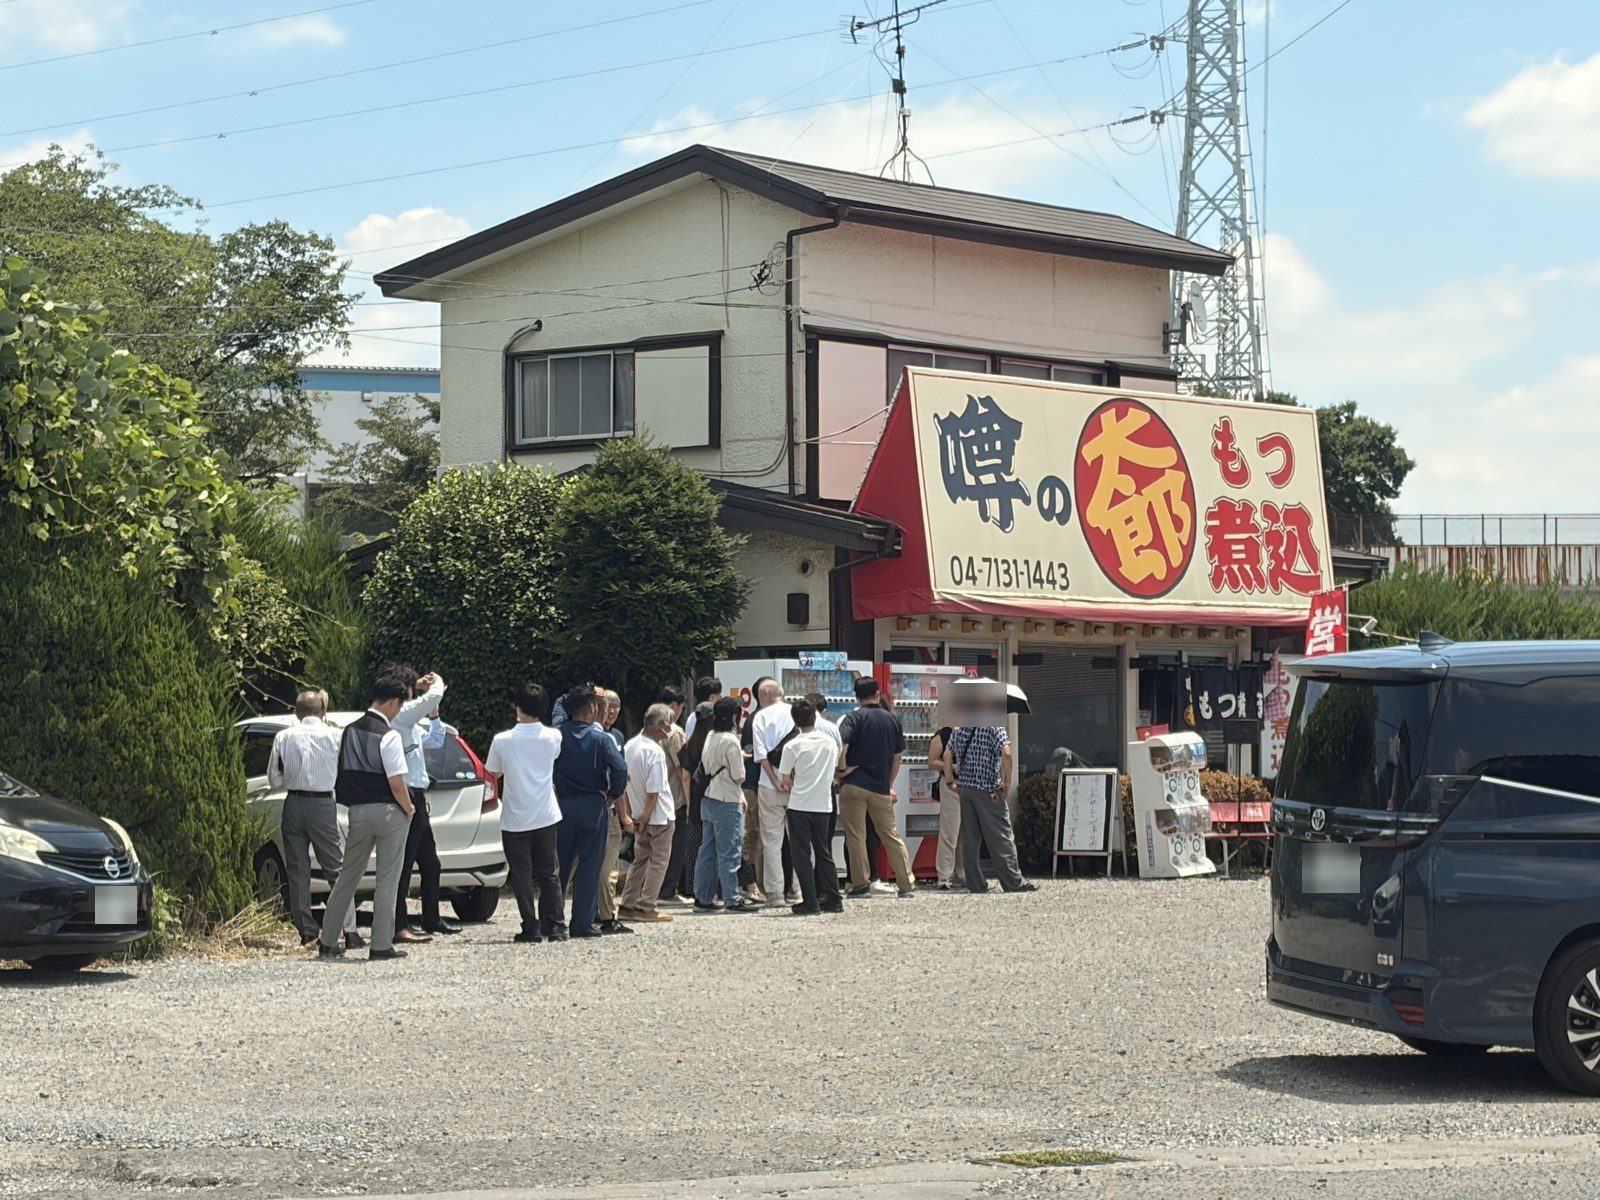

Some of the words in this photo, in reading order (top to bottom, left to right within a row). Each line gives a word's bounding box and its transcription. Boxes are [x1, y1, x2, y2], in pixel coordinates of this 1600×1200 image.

[1211, 415, 1296, 490] もつ
[1081, 407, 1191, 584] 太郎
[950, 555, 1071, 591] 04-7131-1443
[1204, 495, 1323, 597] 煮込
[1305, 604, 1342, 656] 営
